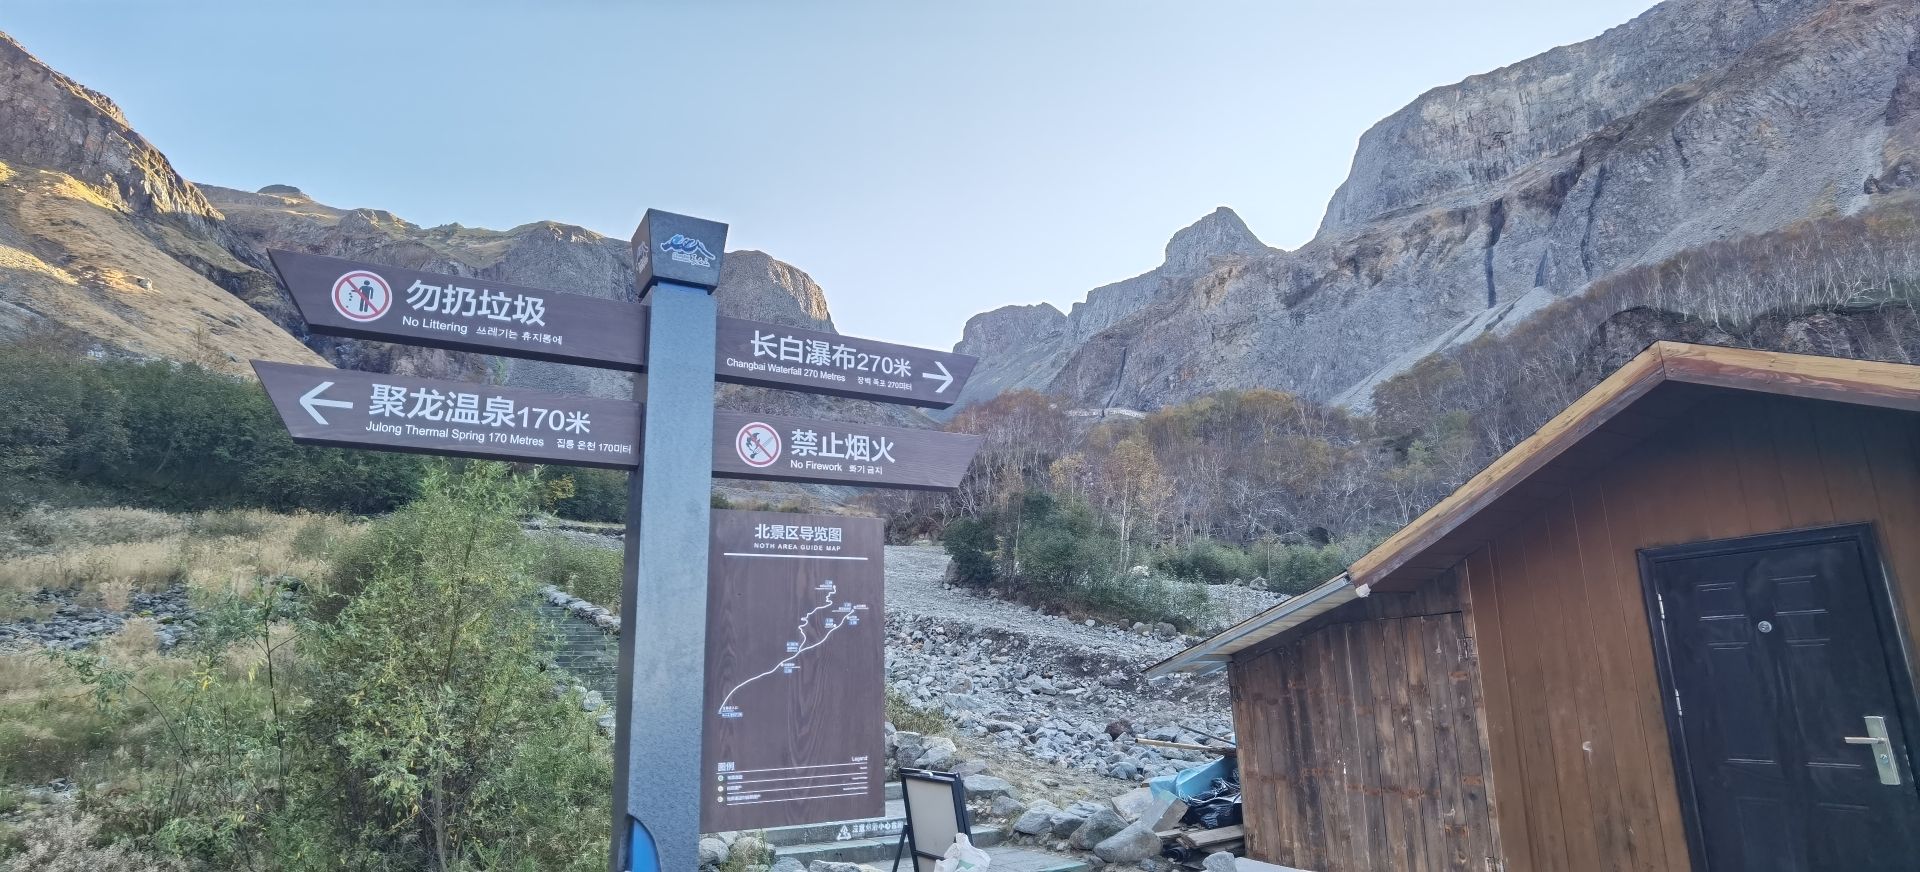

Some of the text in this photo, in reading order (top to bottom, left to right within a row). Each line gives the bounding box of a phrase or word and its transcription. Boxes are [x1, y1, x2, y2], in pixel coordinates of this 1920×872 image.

[405, 279, 546, 327] 勿扔垃圾
[402, 315, 468, 335] No Littering
[750, 330, 912, 378] 长白瀑布270米
[726, 357, 846, 383] Changbai Waterfall 270 Metres
[368, 384, 591, 435] 聚龙温泉170米
[365, 421, 544, 447] Julong Thermal Spring 170 Metres
[790, 429, 896, 464] 禁止烟火
[598, 443, 632, 455] 170미터
[790, 459, 842, 472] No Firework
[754, 523, 842, 543] 北景区导览图
